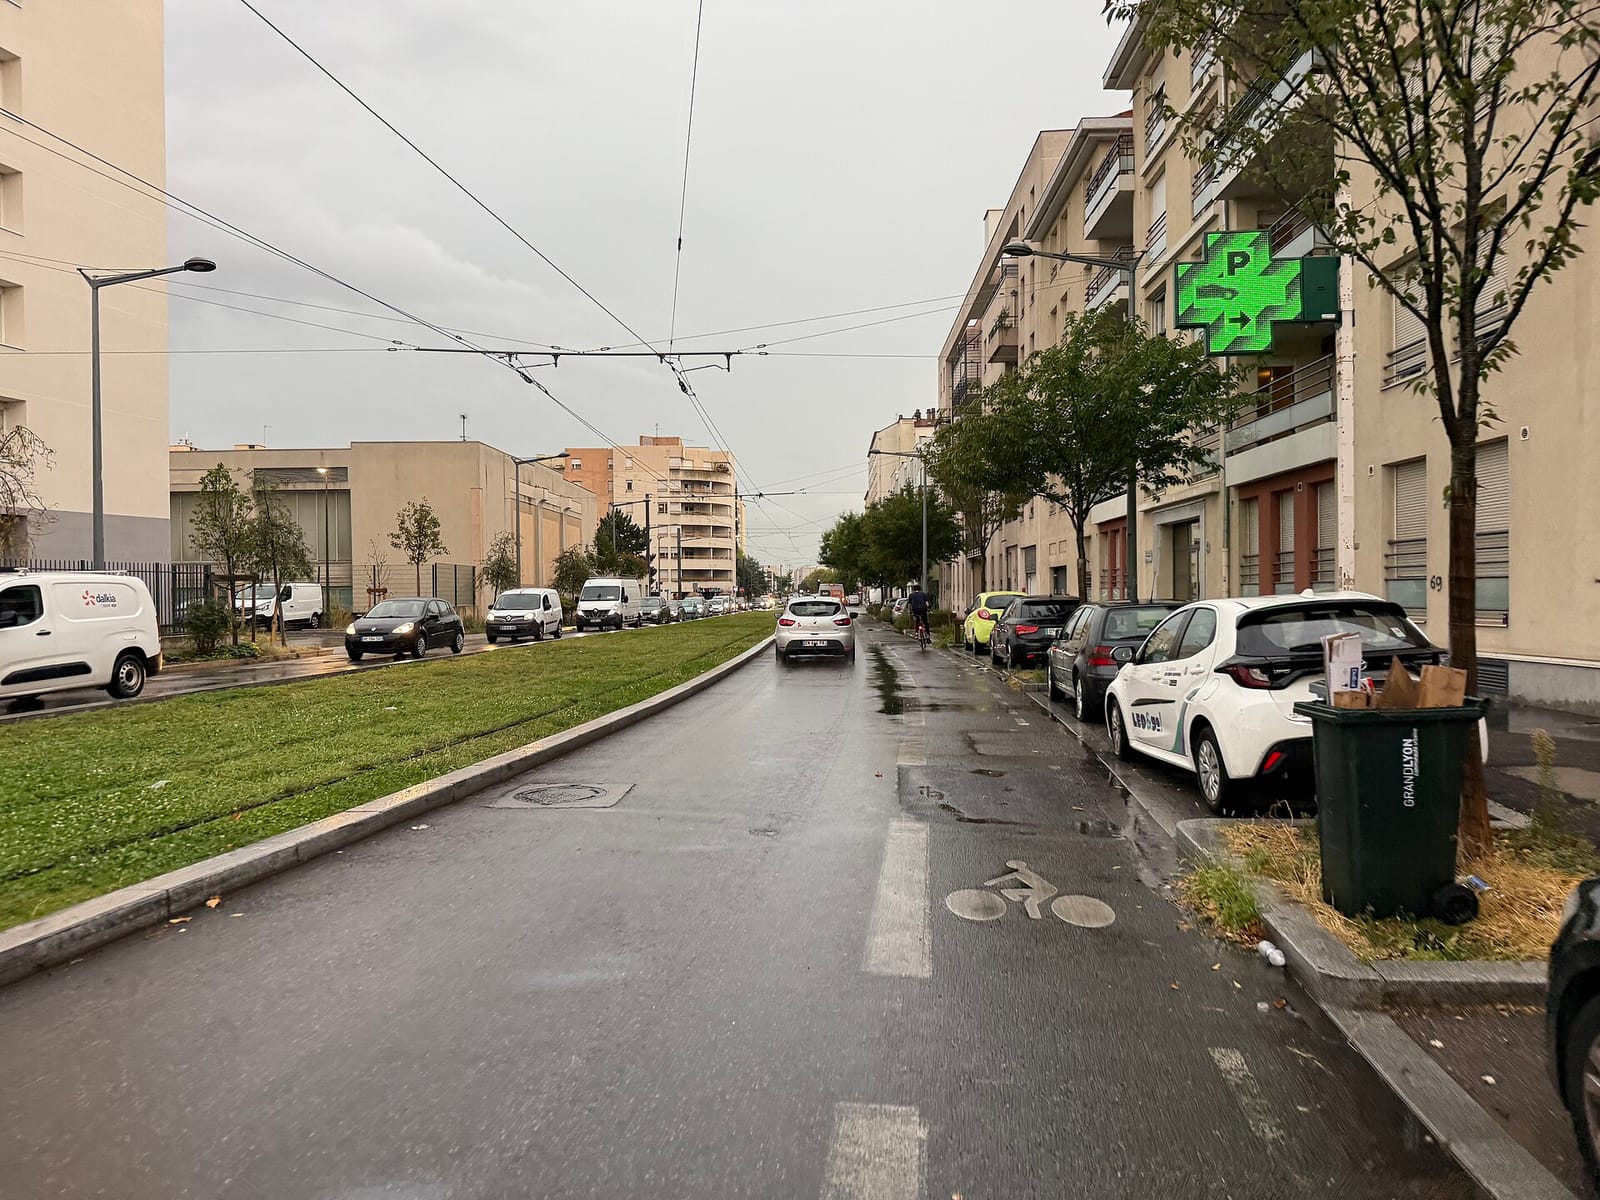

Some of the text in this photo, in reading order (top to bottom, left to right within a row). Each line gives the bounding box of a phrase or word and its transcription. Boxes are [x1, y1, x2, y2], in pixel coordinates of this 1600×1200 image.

[1227, 251, 1251, 276] P
[1430, 575, 1443, 592] 69
[95, 593, 117, 603] dalkia
